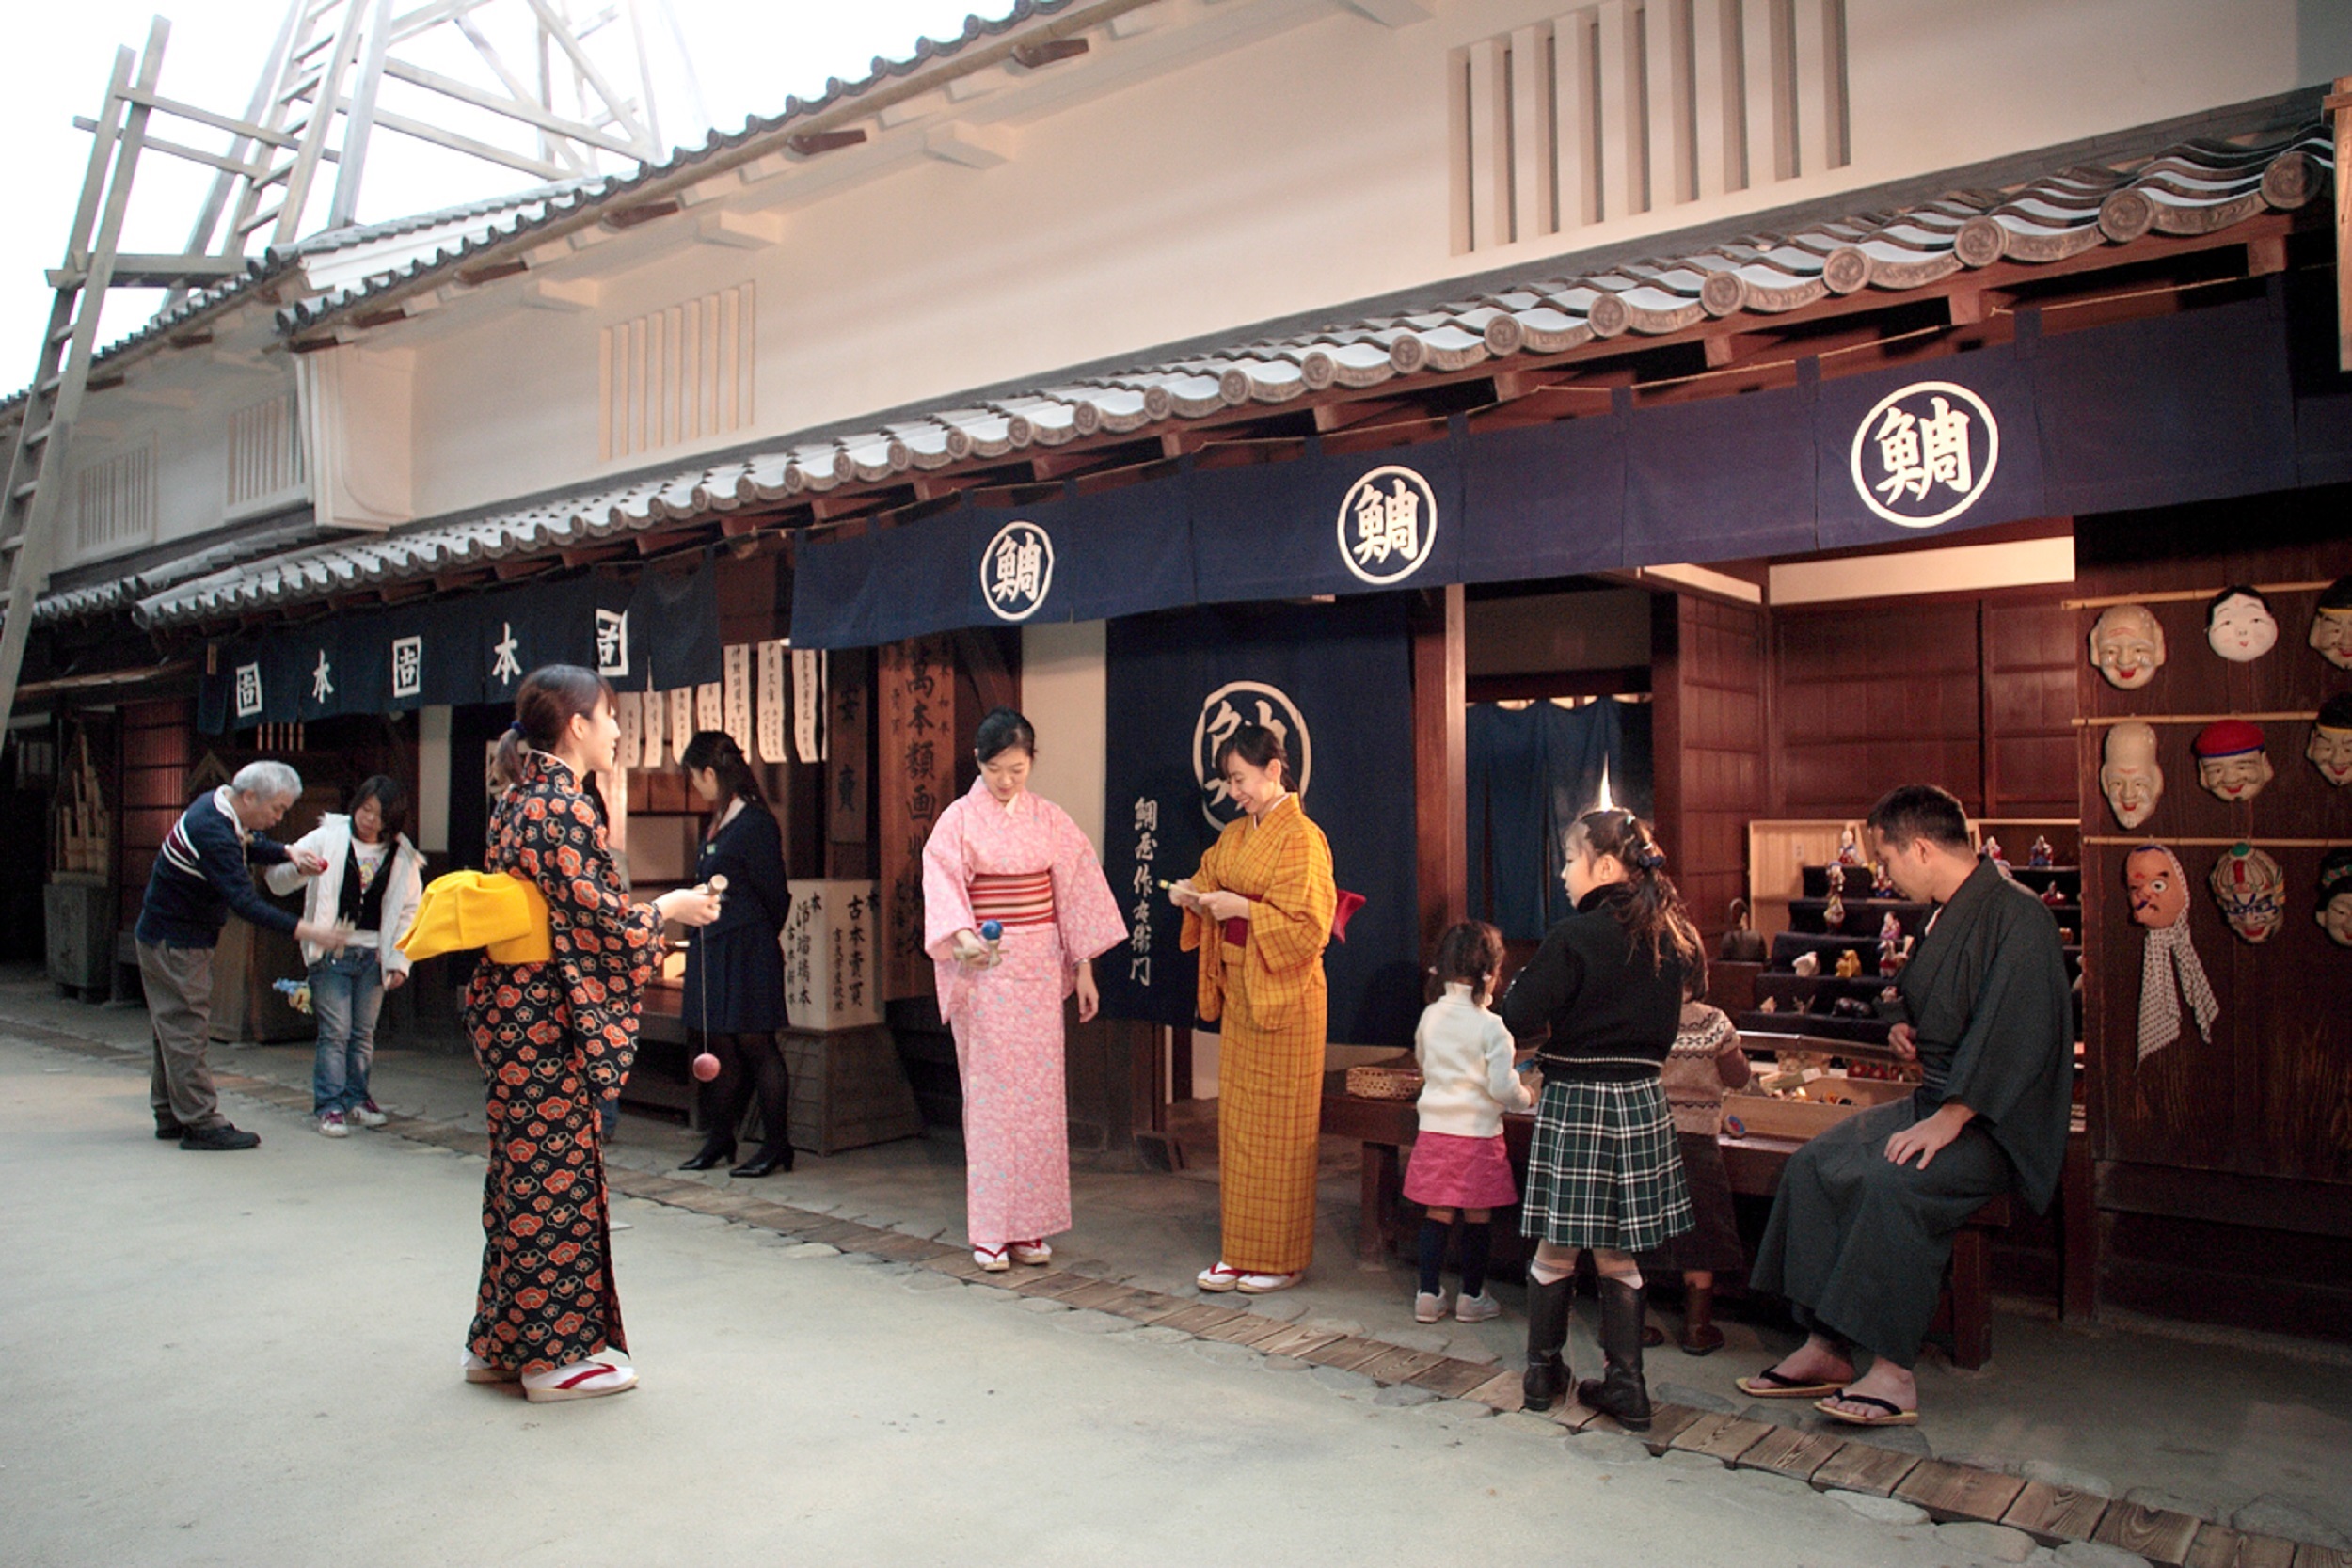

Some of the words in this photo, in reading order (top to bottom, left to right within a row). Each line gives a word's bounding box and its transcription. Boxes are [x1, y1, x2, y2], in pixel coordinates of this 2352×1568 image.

[992, 531, 1041, 602] 鯛
[1354, 478, 1419, 564] 鯛
[1875, 398, 1972, 506] 鯛
[313, 650, 334, 703] 本
[492, 622, 522, 685] 本
